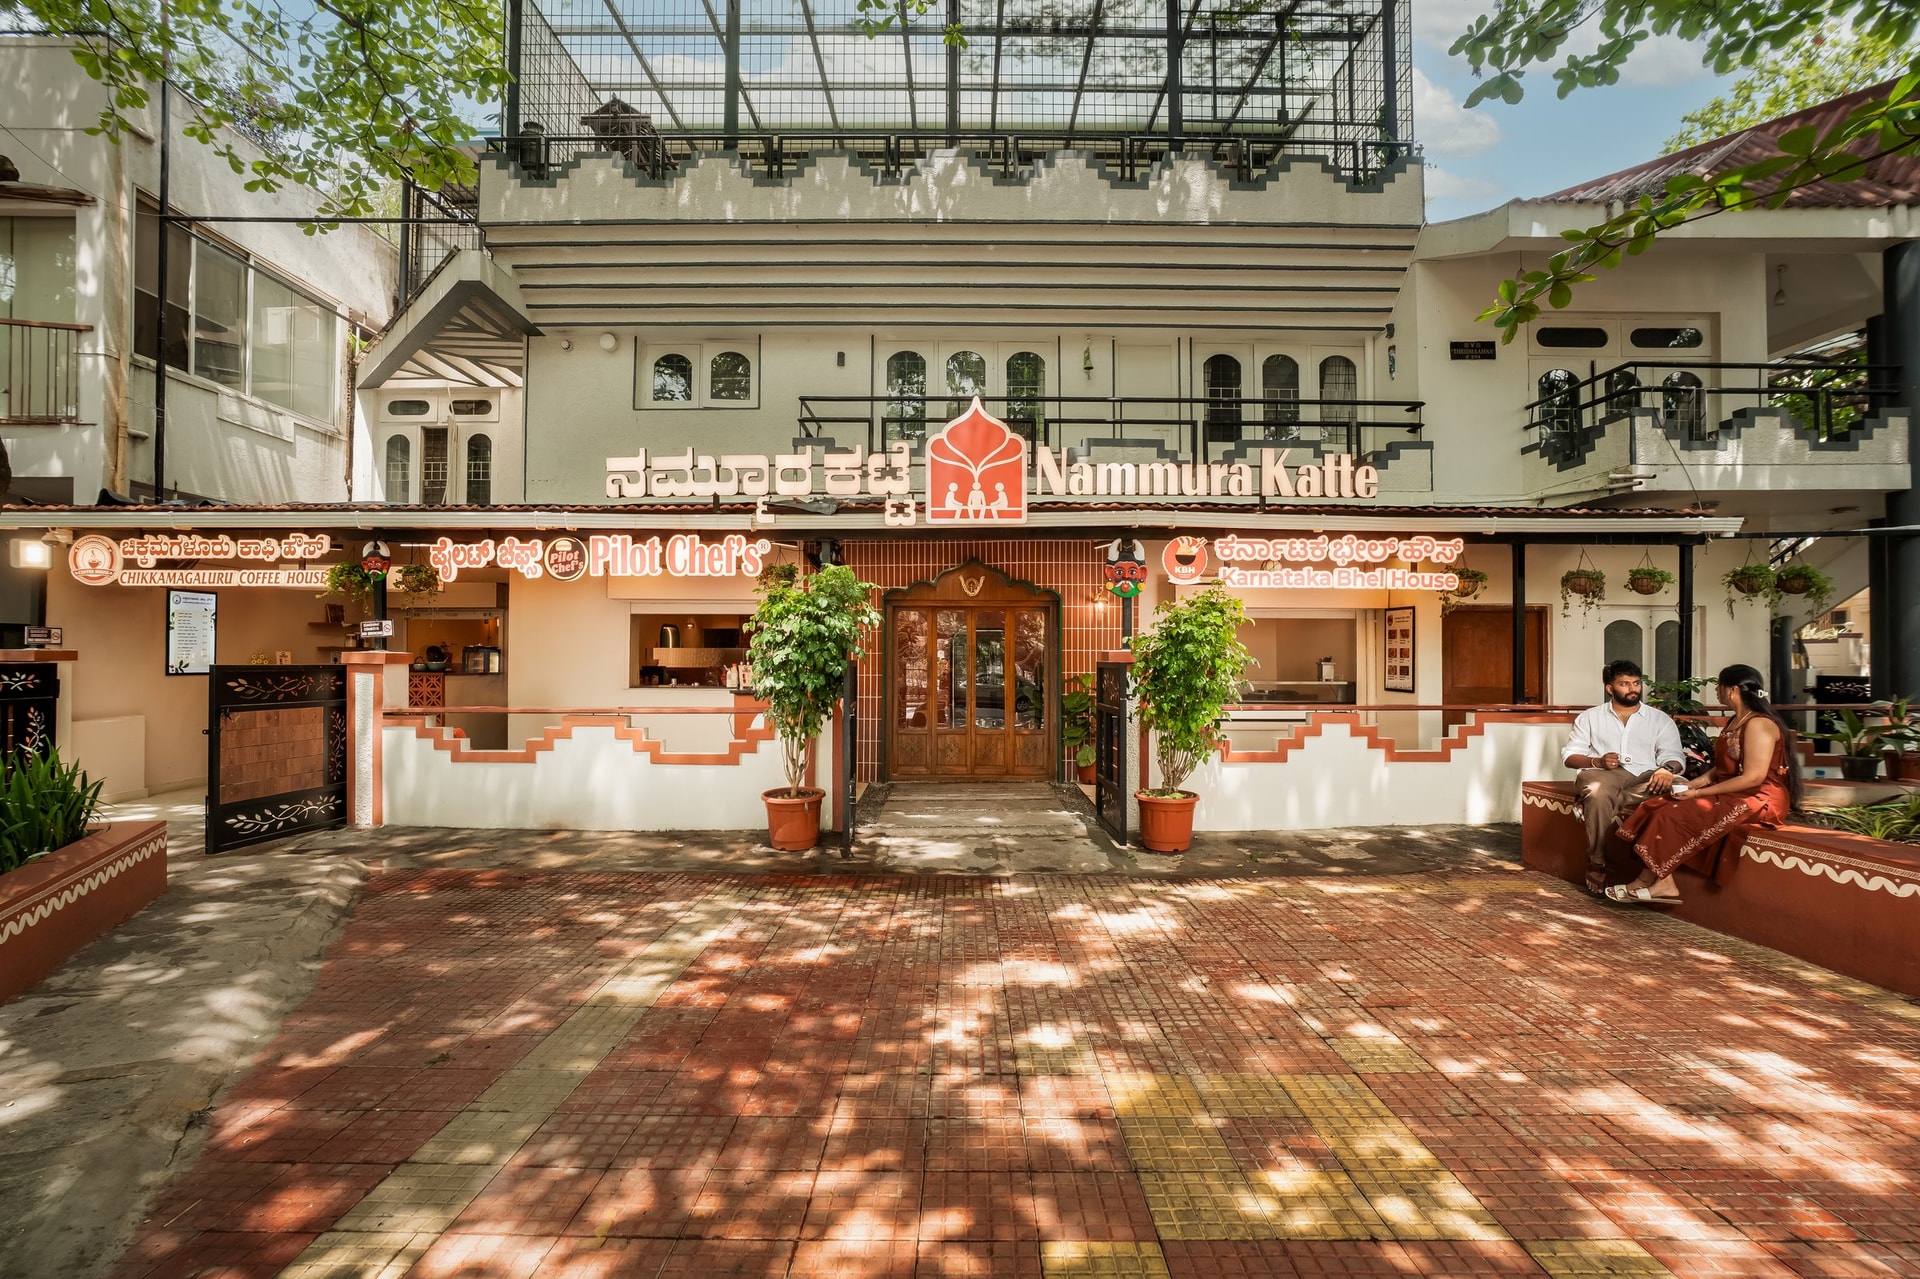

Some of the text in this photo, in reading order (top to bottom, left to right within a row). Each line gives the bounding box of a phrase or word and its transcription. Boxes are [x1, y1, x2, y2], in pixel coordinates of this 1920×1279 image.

[606, 442, 917, 526] ನಮ್ಮೂರ ಕಟ್ಟೆ
[1036, 446, 1379, 498] Nammura Katte
[121, 535, 325, 565] ಚಿಕ್ಕಮಗಳೂರು ಕಾಫಿ ಹೌಸ್
[431, 538, 491, 580] ಪೈಲಟ್
[550, 550, 580, 564] Pilot
[590, 536, 660, 575] Pilot
[1217, 535, 1463, 564] ಕರ್ನಾಟಕ ಭೇಲ್ ಹೌಸ್
[120, 571, 327, 585] CHIKKAMAGALURU COFFEE HOUSE
[551, 560, 584, 574] Chef's
[1174, 565, 1196, 574] KBH
[1222, 567, 1458, 588] Karnataka Bhel House
